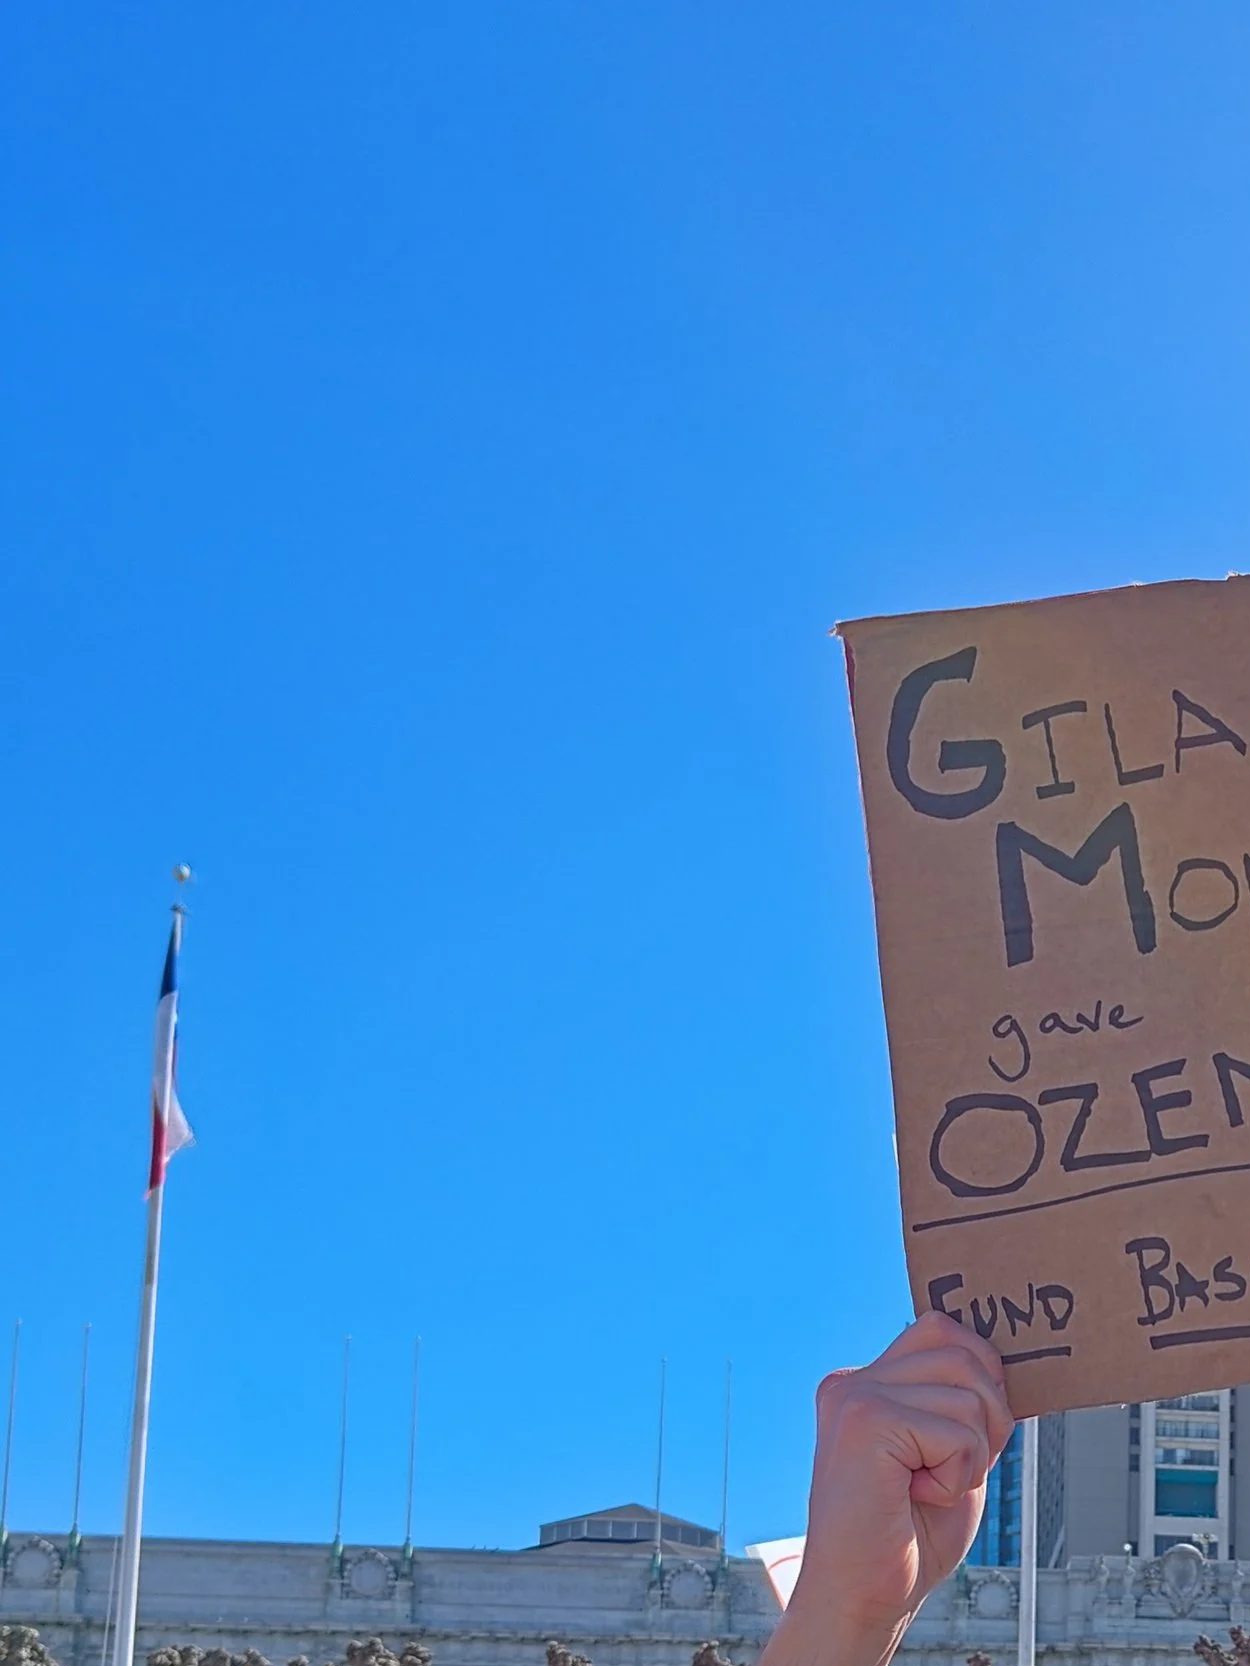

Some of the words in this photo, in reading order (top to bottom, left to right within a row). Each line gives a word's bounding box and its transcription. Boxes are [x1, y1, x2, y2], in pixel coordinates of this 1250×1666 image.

[887, 646, 1247, 819] GILA
[989, 1000, 1144, 1081] gave
[930, 1274, 1074, 1337] FUND
